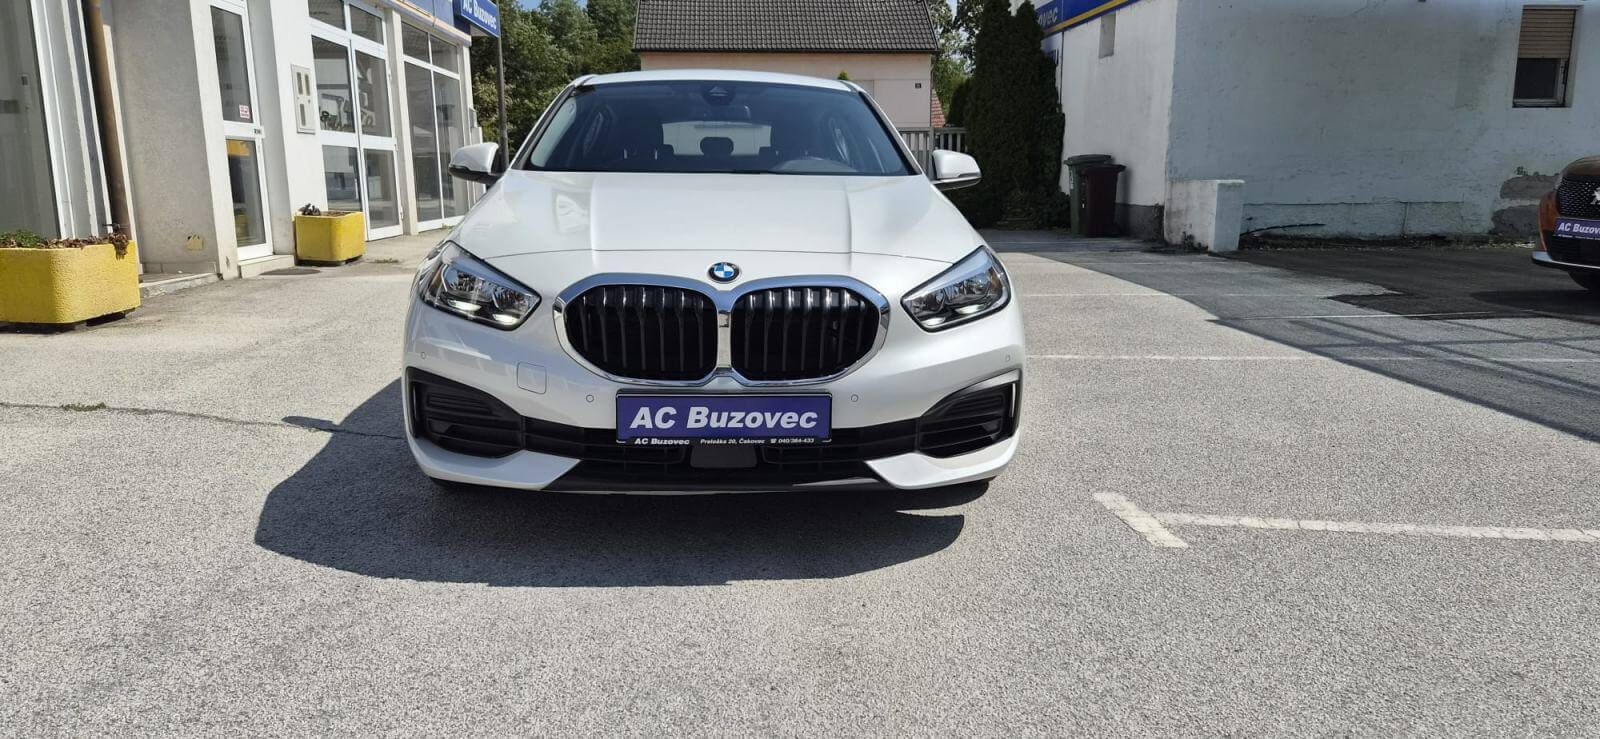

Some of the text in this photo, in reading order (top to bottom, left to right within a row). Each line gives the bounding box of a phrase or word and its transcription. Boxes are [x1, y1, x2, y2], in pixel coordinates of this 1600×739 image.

[474, 0, 497, 29] Buzovec
[1558, 222, 1600, 234] AC Buzov
[630, 406, 818, 429] AC Buzovec
[634, 437, 649, 445] AC
[650, 437, 690, 445] Buzovec
